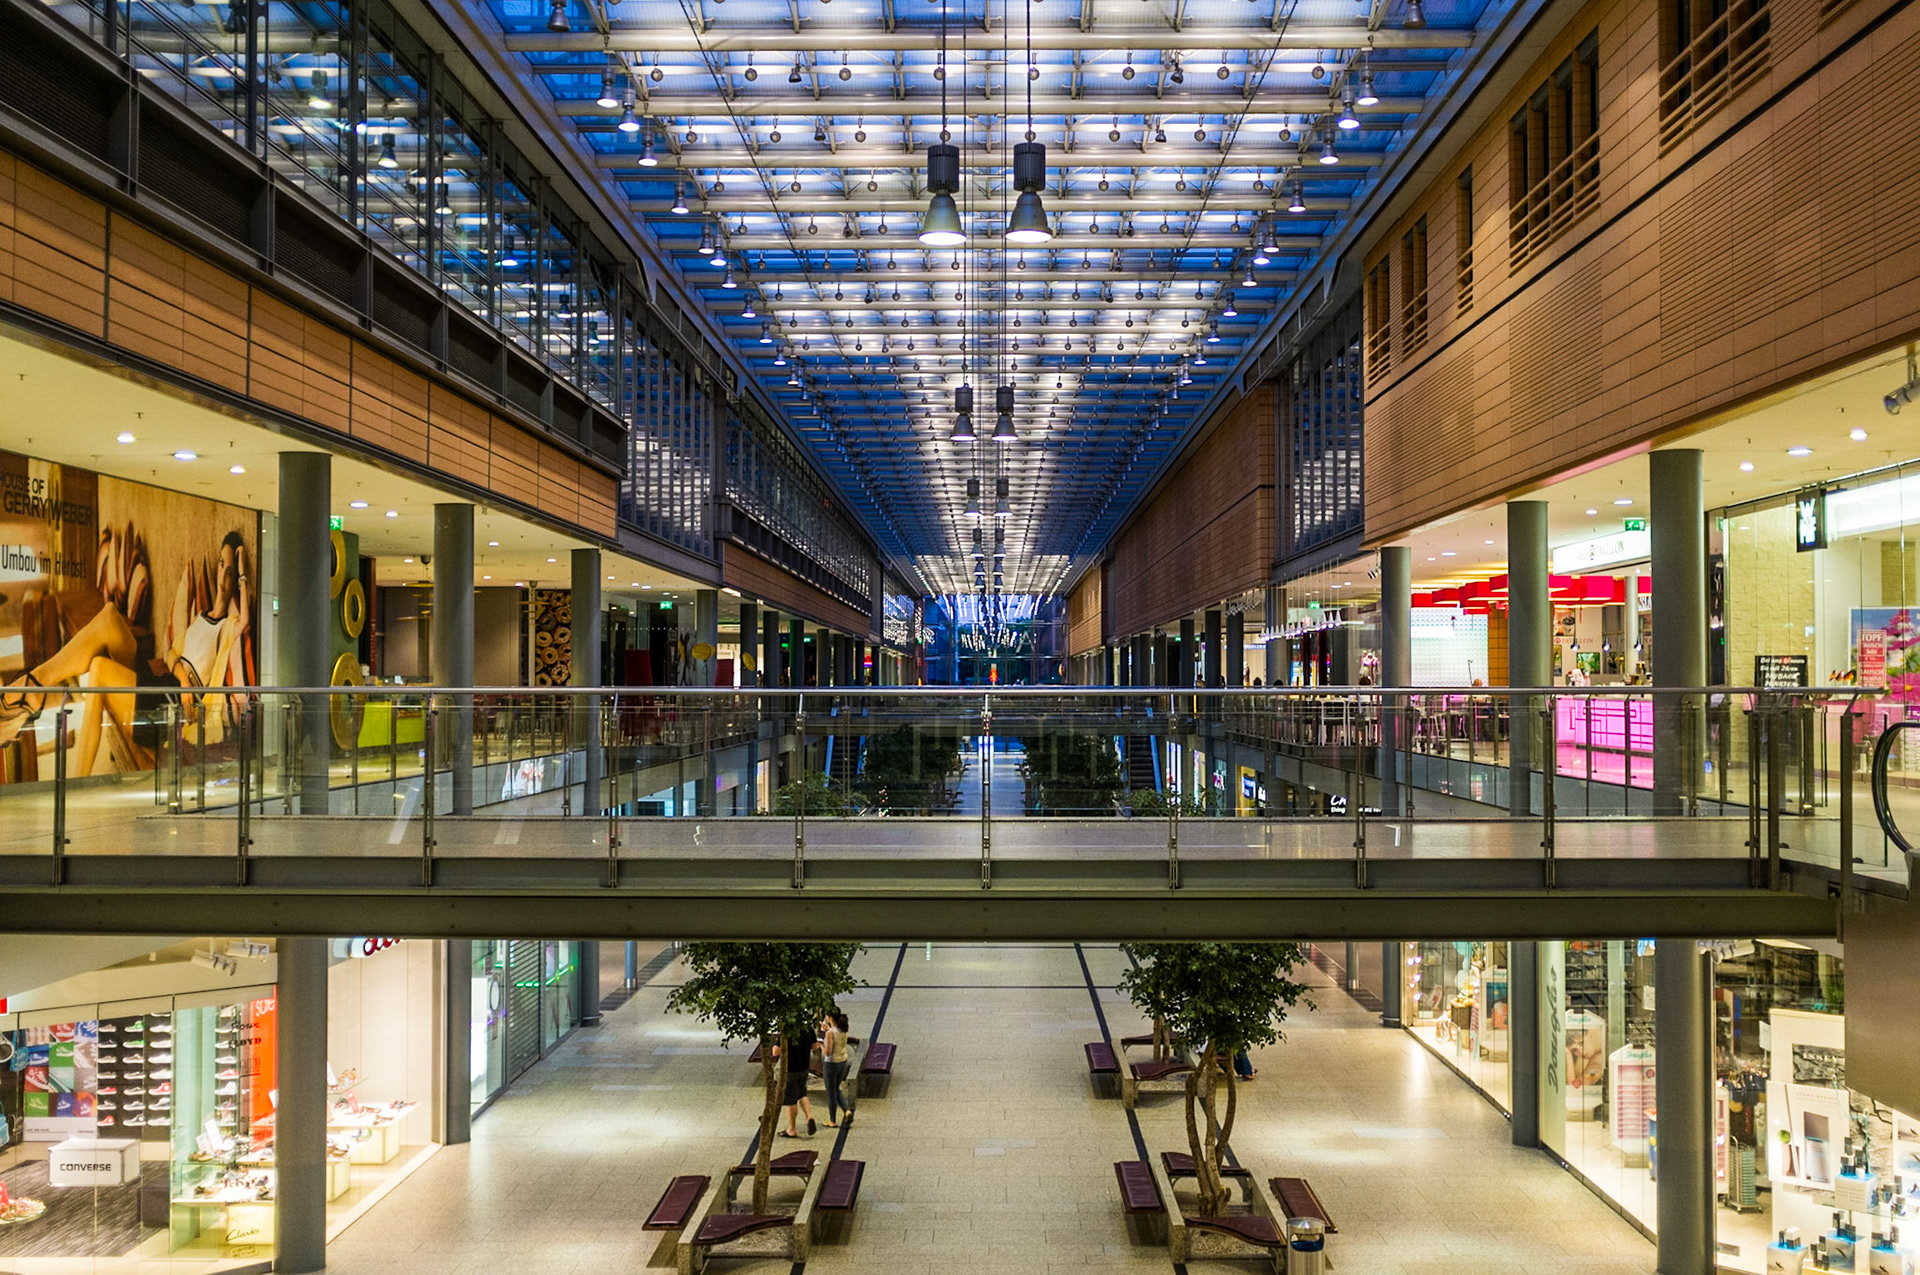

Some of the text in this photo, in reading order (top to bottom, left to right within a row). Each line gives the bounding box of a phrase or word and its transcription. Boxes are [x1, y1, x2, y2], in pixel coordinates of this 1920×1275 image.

[32, 478, 44, 494] OF
[3, 482, 93, 530] GERRY WEBER
[2, 544, 87, 579] Umbau im Herbst!
[60, 1163, 112, 1171] CONVERSE
[225, 1227, 260, 1242] Clarks
